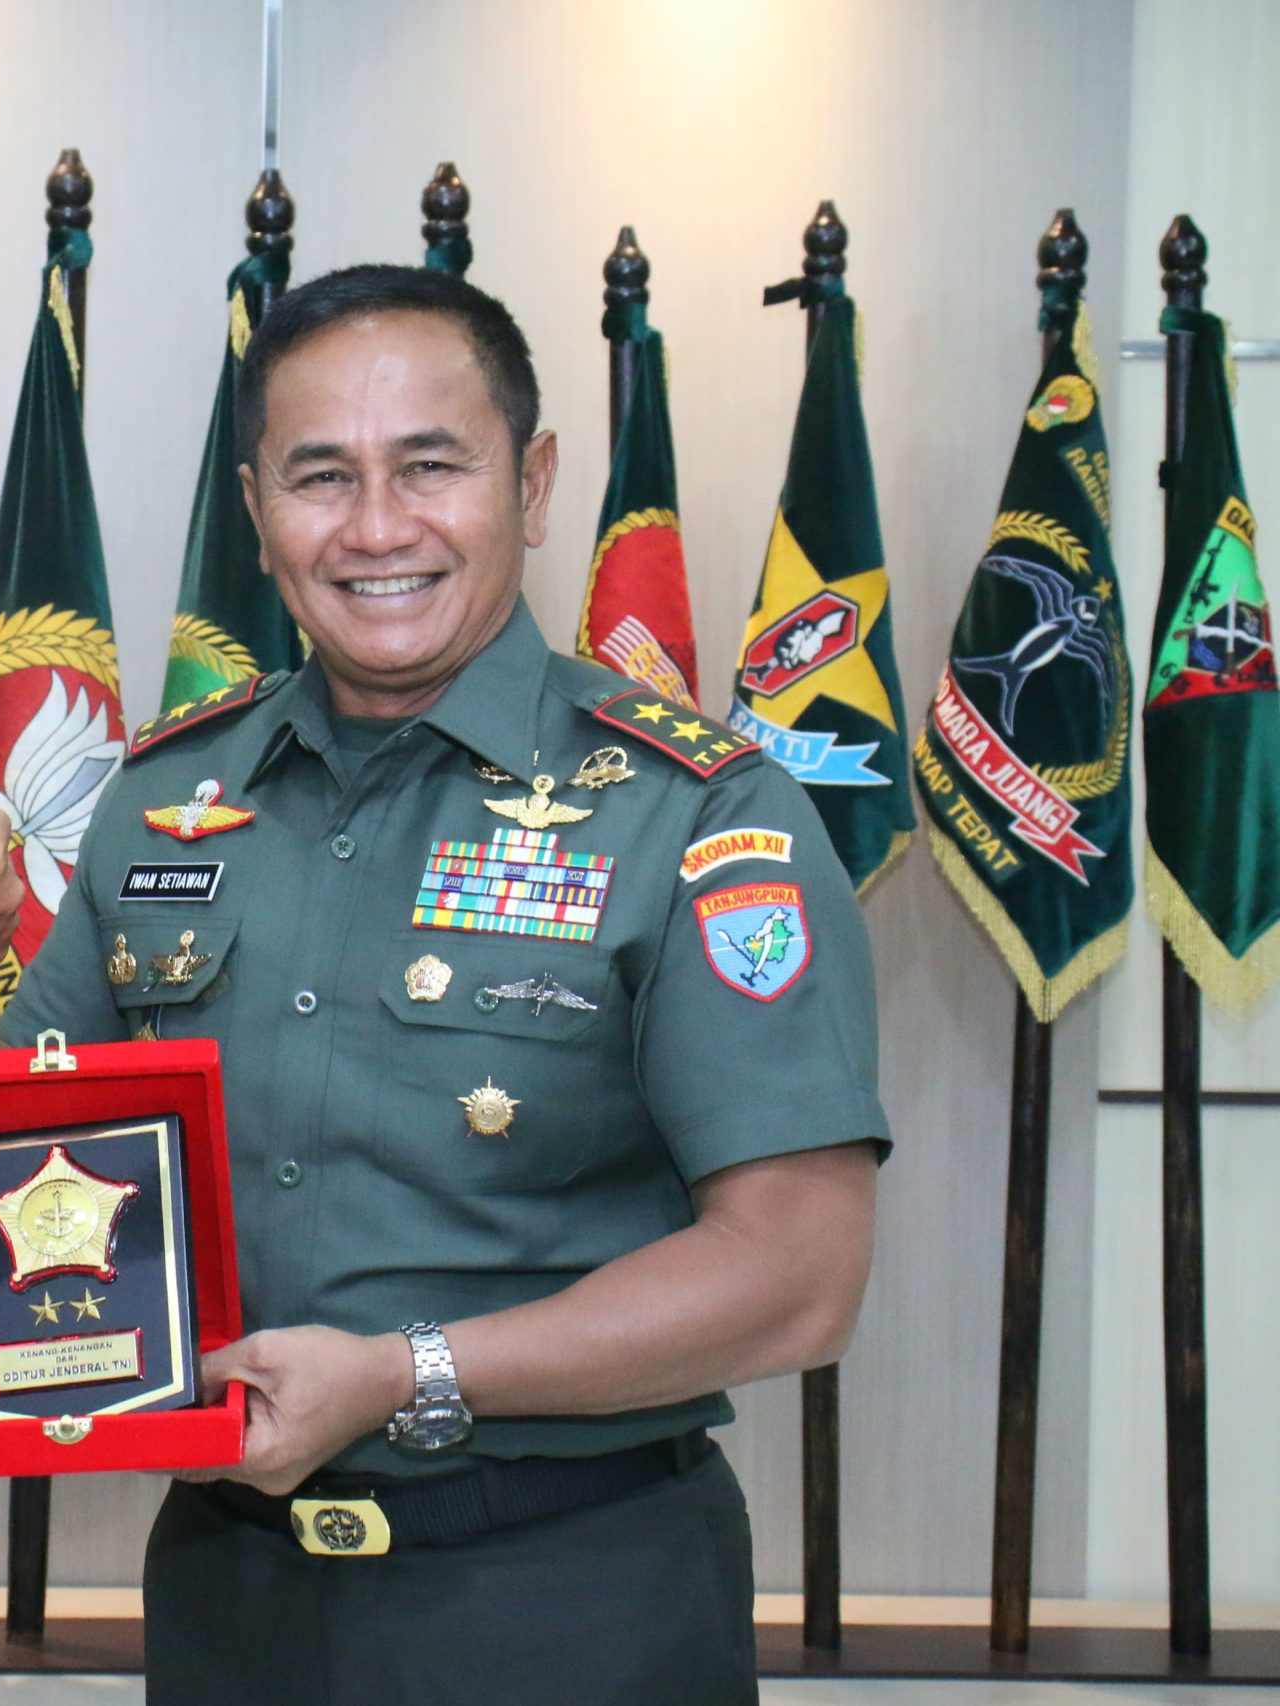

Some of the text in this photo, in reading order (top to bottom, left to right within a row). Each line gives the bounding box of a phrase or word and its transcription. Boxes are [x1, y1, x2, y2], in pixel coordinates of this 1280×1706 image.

[729, 711, 810, 761] SAKTI
[693, 735, 748, 765] TNI
[981, 762, 1067, 831] JUANG
[763, 835, 784, 854] XII
[947, 794, 1018, 871] TEPAT
[129, 872, 210, 889] IWAN SETIAWAN
[705, 886, 797, 914] TANJUNGPURA
[20, 1342, 112, 1358] KENANG-KENANGAN
[56, 1355, 77, 1363] DARI
[3, 1359, 131, 1383] ODITUR JENDERAL TNI
